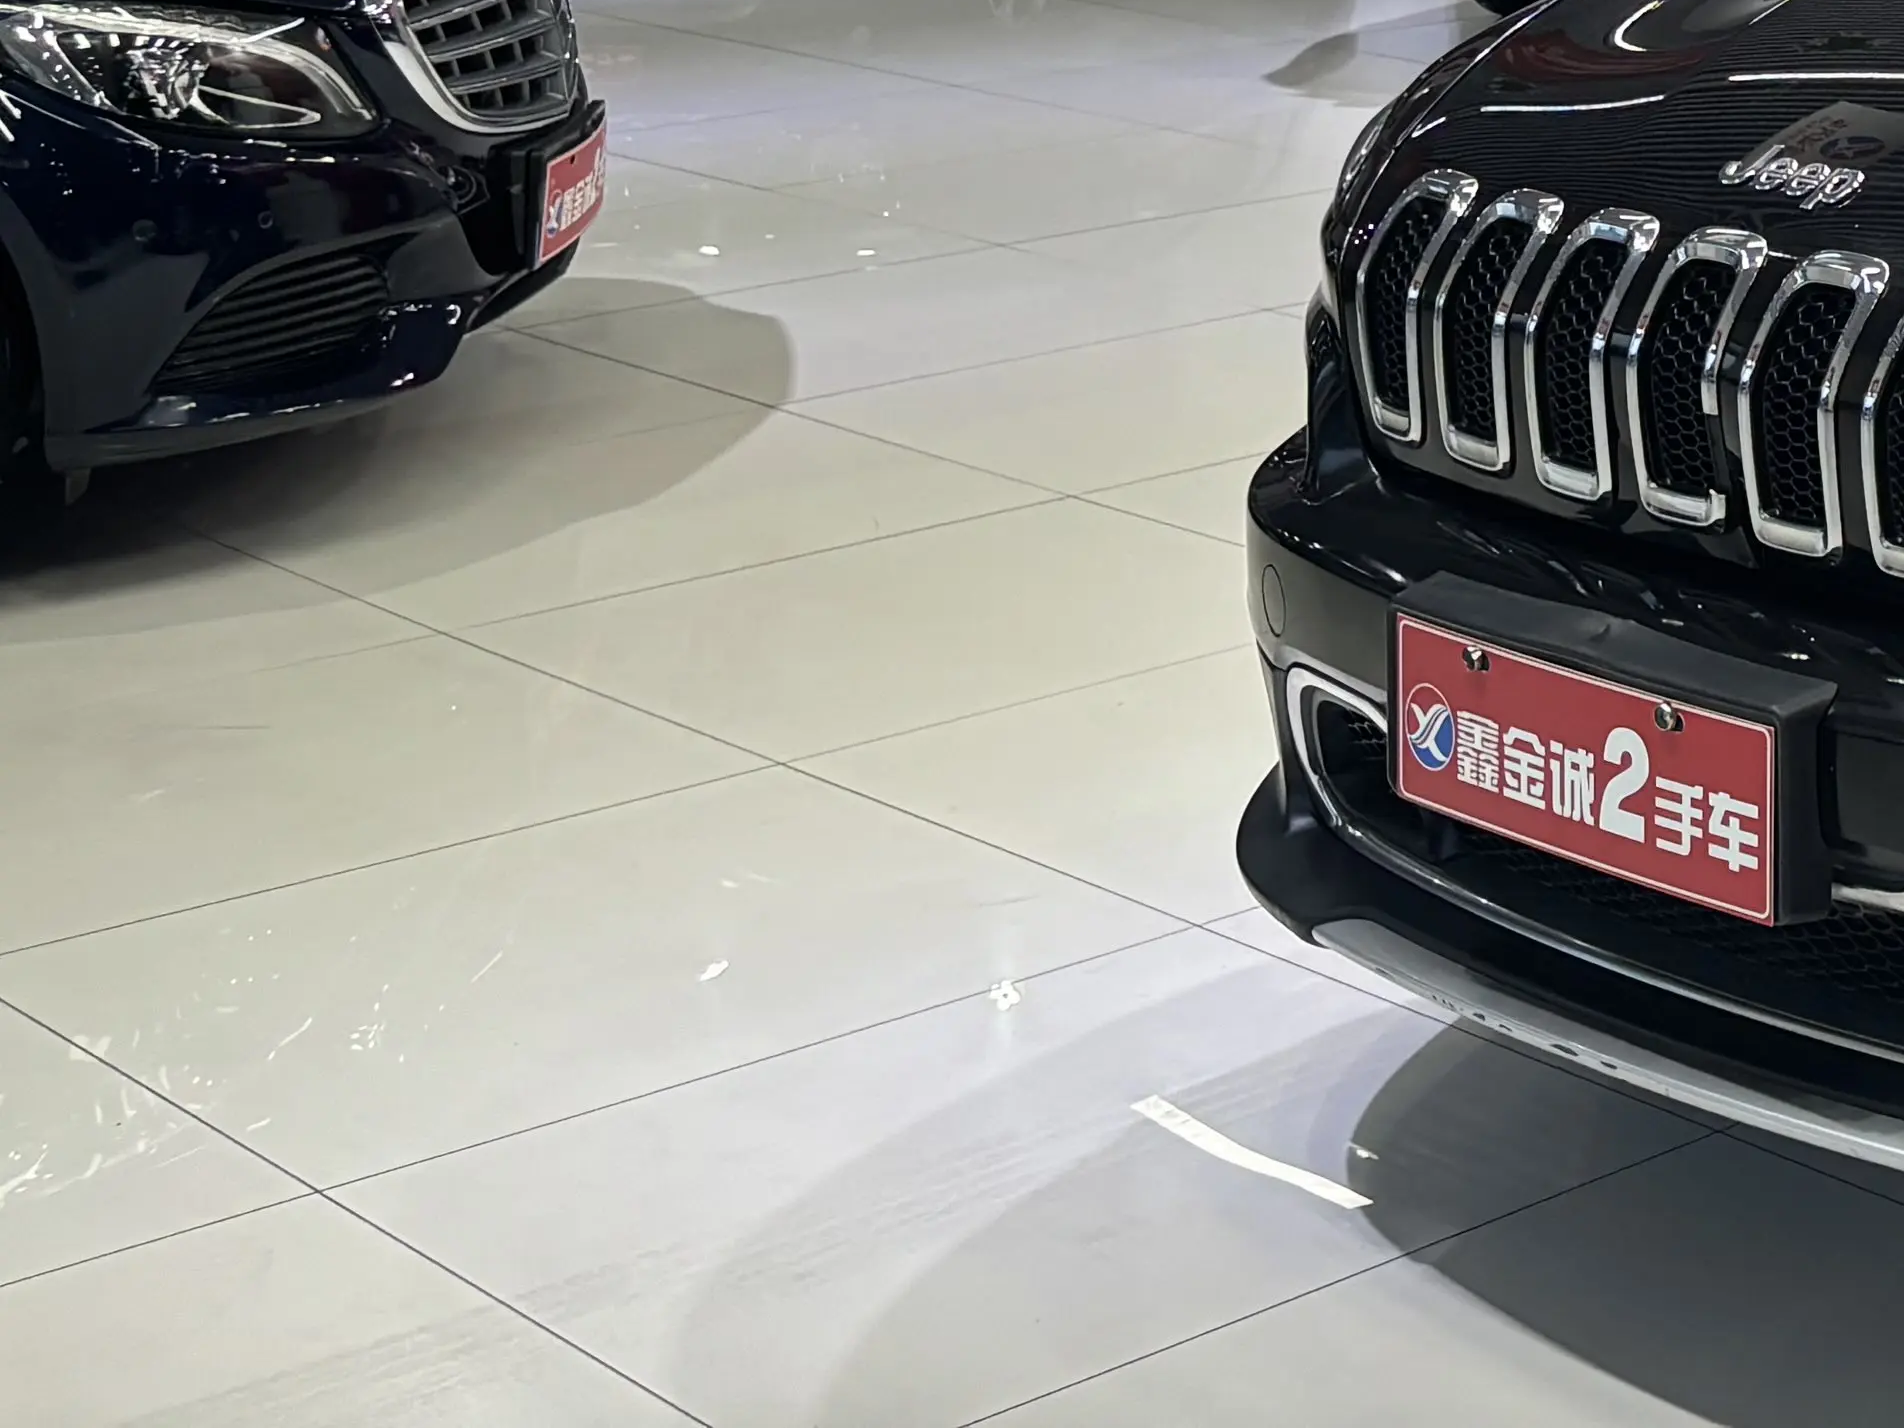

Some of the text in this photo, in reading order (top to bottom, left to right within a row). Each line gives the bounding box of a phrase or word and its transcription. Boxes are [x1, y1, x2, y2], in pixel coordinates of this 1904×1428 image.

[1717, 144, 1866, 210] Jeep
[1456, 710, 1760, 873] 鑫金诚2手车
